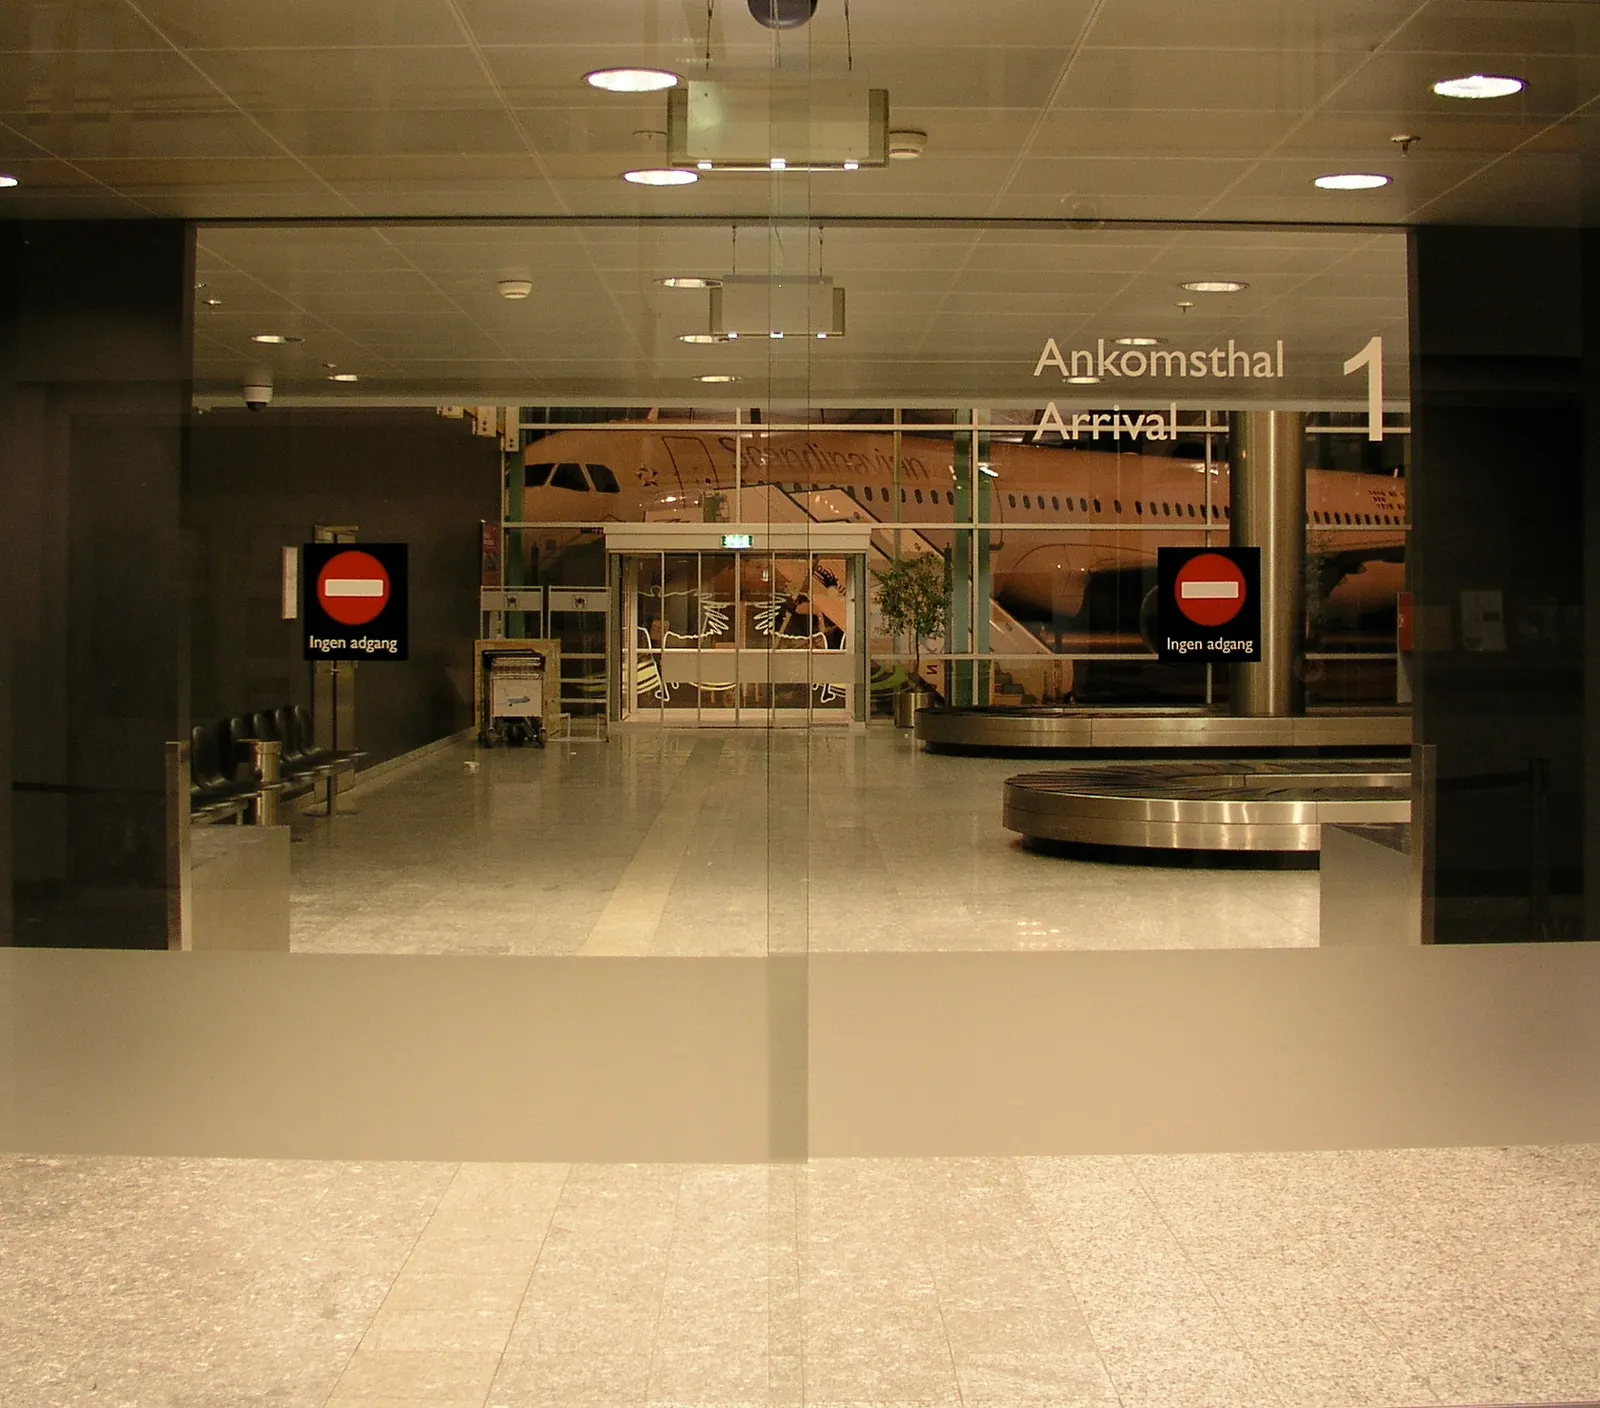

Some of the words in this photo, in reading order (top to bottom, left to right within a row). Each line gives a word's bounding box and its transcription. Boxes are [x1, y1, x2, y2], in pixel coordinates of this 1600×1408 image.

[1034, 337, 1284, 379] Ankomsthal
[1343, 335, 1384, 443] 1
[1034, 401, 1178, 442] Arrival
[309, 635, 346, 653] Ingen
[350, 635, 398, 654] adgang
[1166, 636, 1203, 654] Ingen
[1207, 636, 1254, 654] adgang
